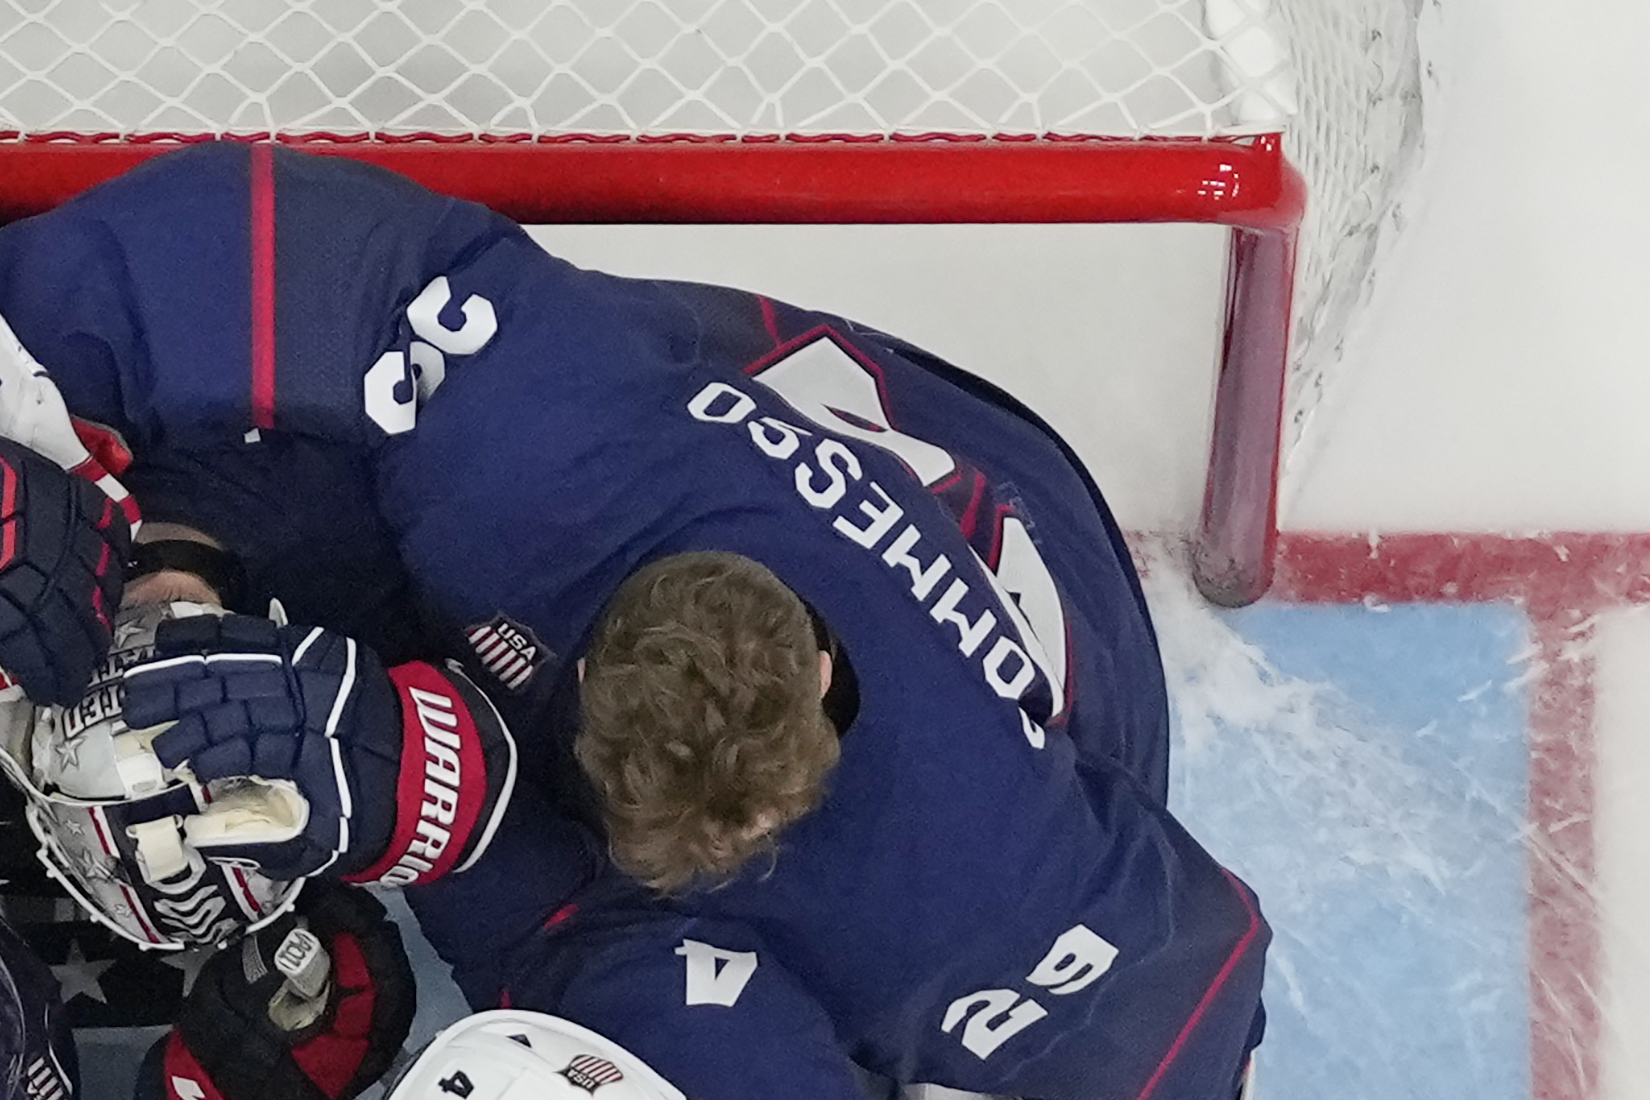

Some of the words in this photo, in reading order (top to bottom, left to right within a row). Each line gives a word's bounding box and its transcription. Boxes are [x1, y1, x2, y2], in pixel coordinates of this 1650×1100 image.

[497, 622, 536, 661] USA
[379, 686, 461, 887] WARRIO
[675, 938, 758, 1008] 4
[941, 923, 1119, 1060] 29
[438, 1070, 475, 1100] 4
[566, 1068, 597, 1089] USA
